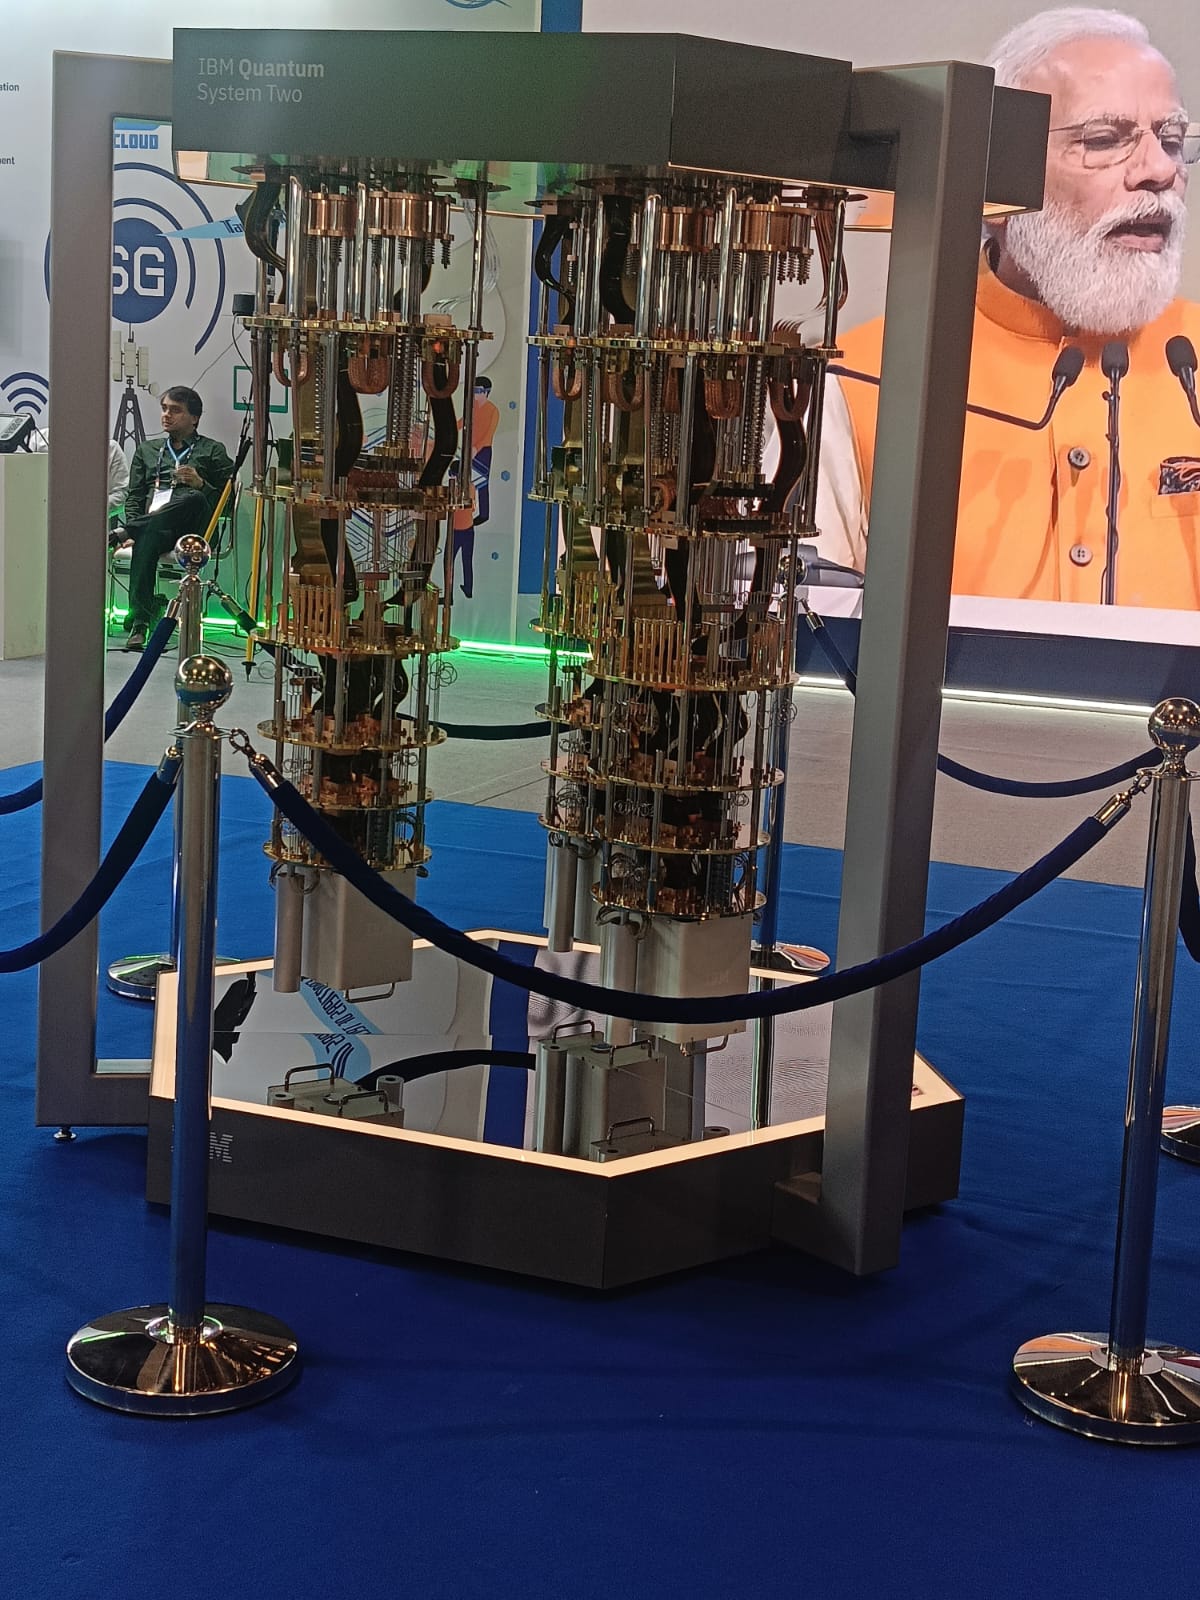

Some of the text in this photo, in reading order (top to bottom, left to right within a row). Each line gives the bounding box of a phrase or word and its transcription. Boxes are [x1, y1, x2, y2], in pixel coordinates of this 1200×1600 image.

[198, 57, 325, 80] IBM Quantum
[197, 82, 303, 104] System Two
